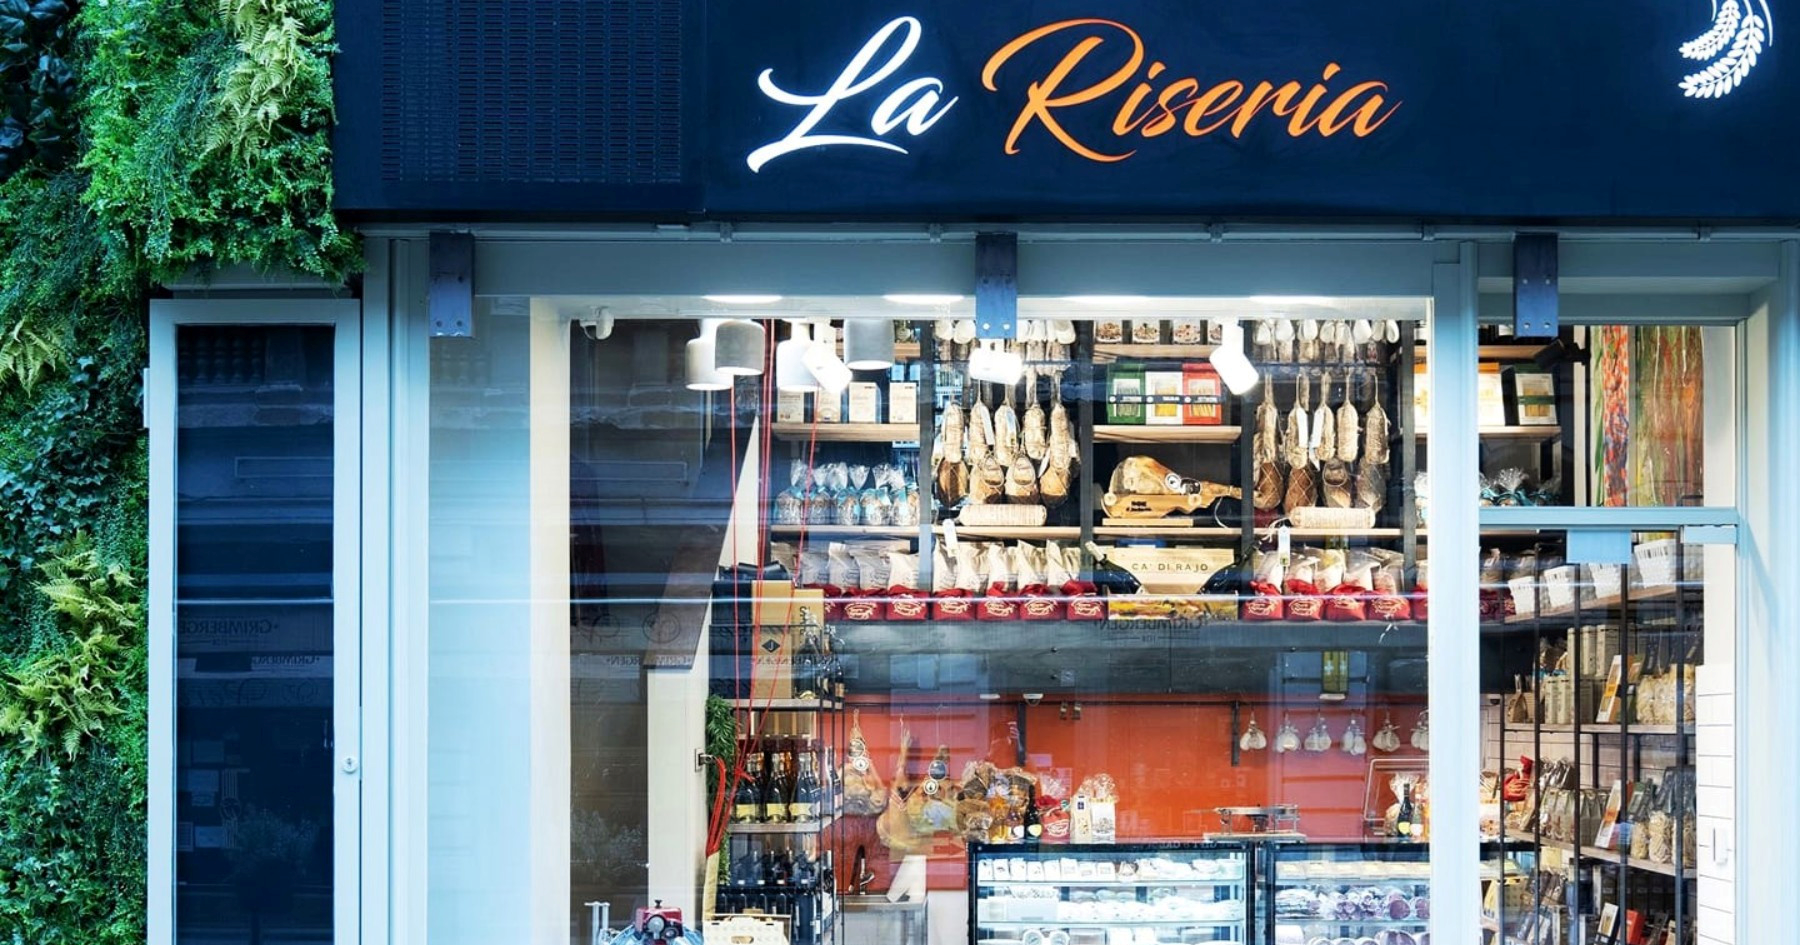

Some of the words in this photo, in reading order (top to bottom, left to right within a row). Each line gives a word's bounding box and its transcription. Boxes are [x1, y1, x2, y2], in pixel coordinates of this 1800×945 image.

[746, 16, 958, 173] La
[981, 18, 1402, 163] Riseria
[1158, 563, 1170, 571] DI
[1176, 563, 1208, 573] RAJO
